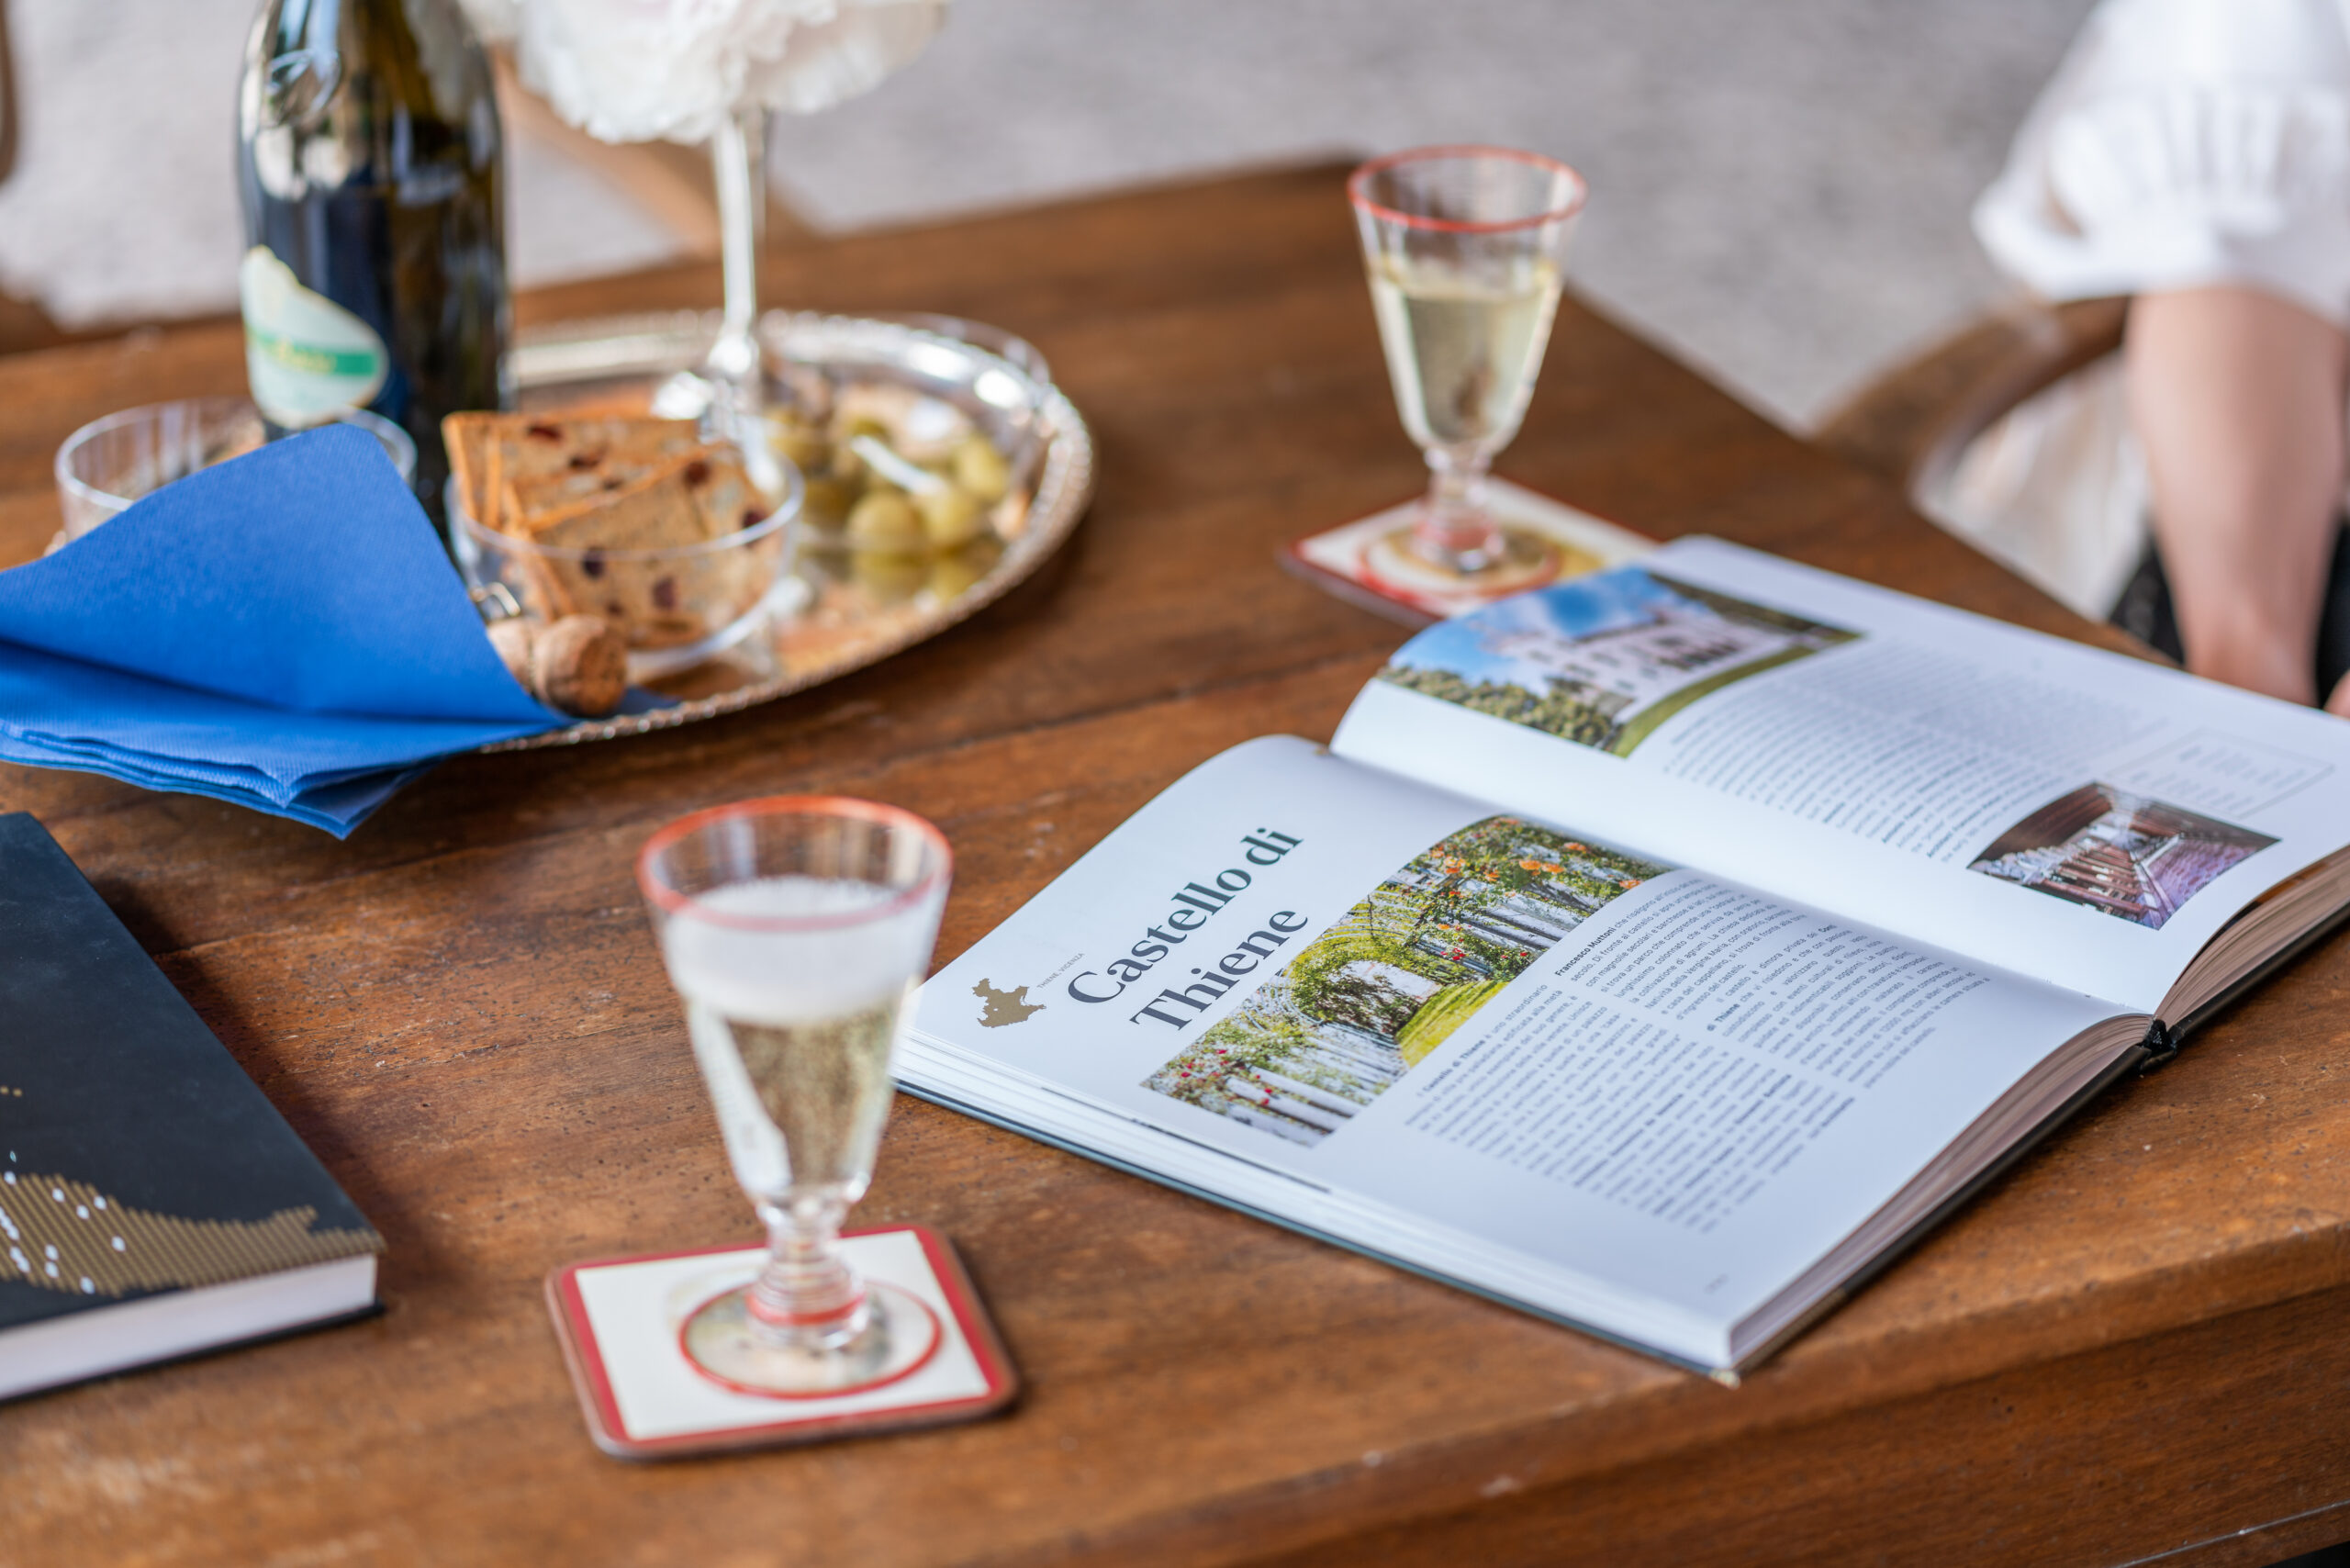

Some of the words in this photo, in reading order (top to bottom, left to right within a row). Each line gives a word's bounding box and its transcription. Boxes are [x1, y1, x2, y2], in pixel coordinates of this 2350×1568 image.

[1068, 868, 1252, 1003] Castello
[1240, 827, 1304, 866] di
[1129, 910, 1308, 1031] Thiene
[1554, 947, 1591, 977] Francesco
[1587, 926, 1617, 948] Muttoni
[1614, 919, 1628, 928] che
[1571, 963, 1595, 981] secolo.
[1600, 939, 1623, 956] fronte
[1628, 916, 1654, 935] castello
[1585, 976, 1601, 987] con
[1597, 952, 1628, 976] magnolie
[1606, 972, 1627, 987] trova
[1624, 964, 1636, 972] un
[1633, 949, 1653, 965] parco
[1651, 940, 1666, 950] che
[1663, 916, 1699, 941] comprende
[1614, 966, 1655, 998] lunghissimo
[1654, 940, 1687, 965] colonnato
[1686, 931, 1701, 940] che
[1639, 965, 1677, 997] coltivazione
[1684, 941, 1710, 958] agrumi.
[1667, 996, 1684, 1010] casa
[1694, 959, 1732, 986] cappellano,
[1735, 941, 1754, 953] trova
[1670, 975, 1688, 988] della
[1684, 956, 1711, 974] Vergine
[1707, 943, 1731, 957] Maria,
[1725, 976, 1751, 996] castello
[1759, 953, 1784, 969] dimora
[1505, 984, 1548, 1021] straordinario
